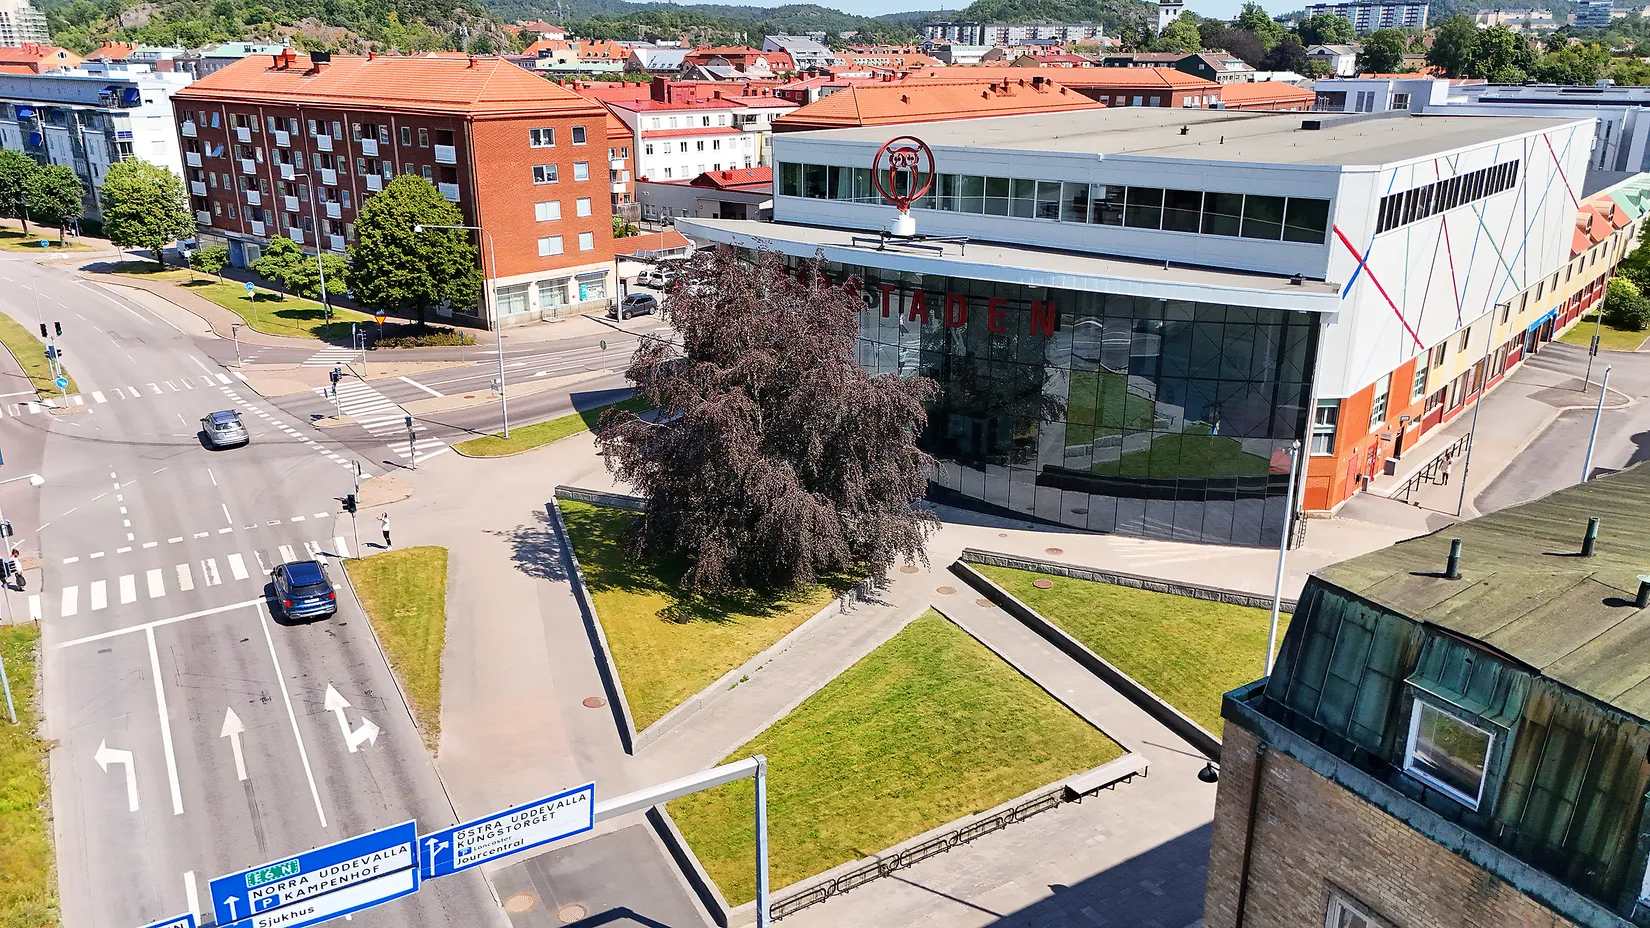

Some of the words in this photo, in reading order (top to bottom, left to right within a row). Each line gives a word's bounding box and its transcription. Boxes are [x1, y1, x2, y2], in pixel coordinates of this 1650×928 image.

[790, 266, 1056, 337] STADEN
[457, 820, 502, 840] ÖSTRA
[511, 793, 587, 823] UDDEVALLA
[457, 811, 556, 849] KUNGSTORGET
[253, 876, 309, 899] NORRA
[319, 846, 408, 878] UDDEVALLA
[254, 870, 274, 882] E6
[281, 861, 293, 874] N
[457, 838, 524, 866] Jourcentral
[262, 898, 273, 909] P
[284, 865, 380, 901] KAMPENHOF
[259, 906, 315, 928] Sjukhus
